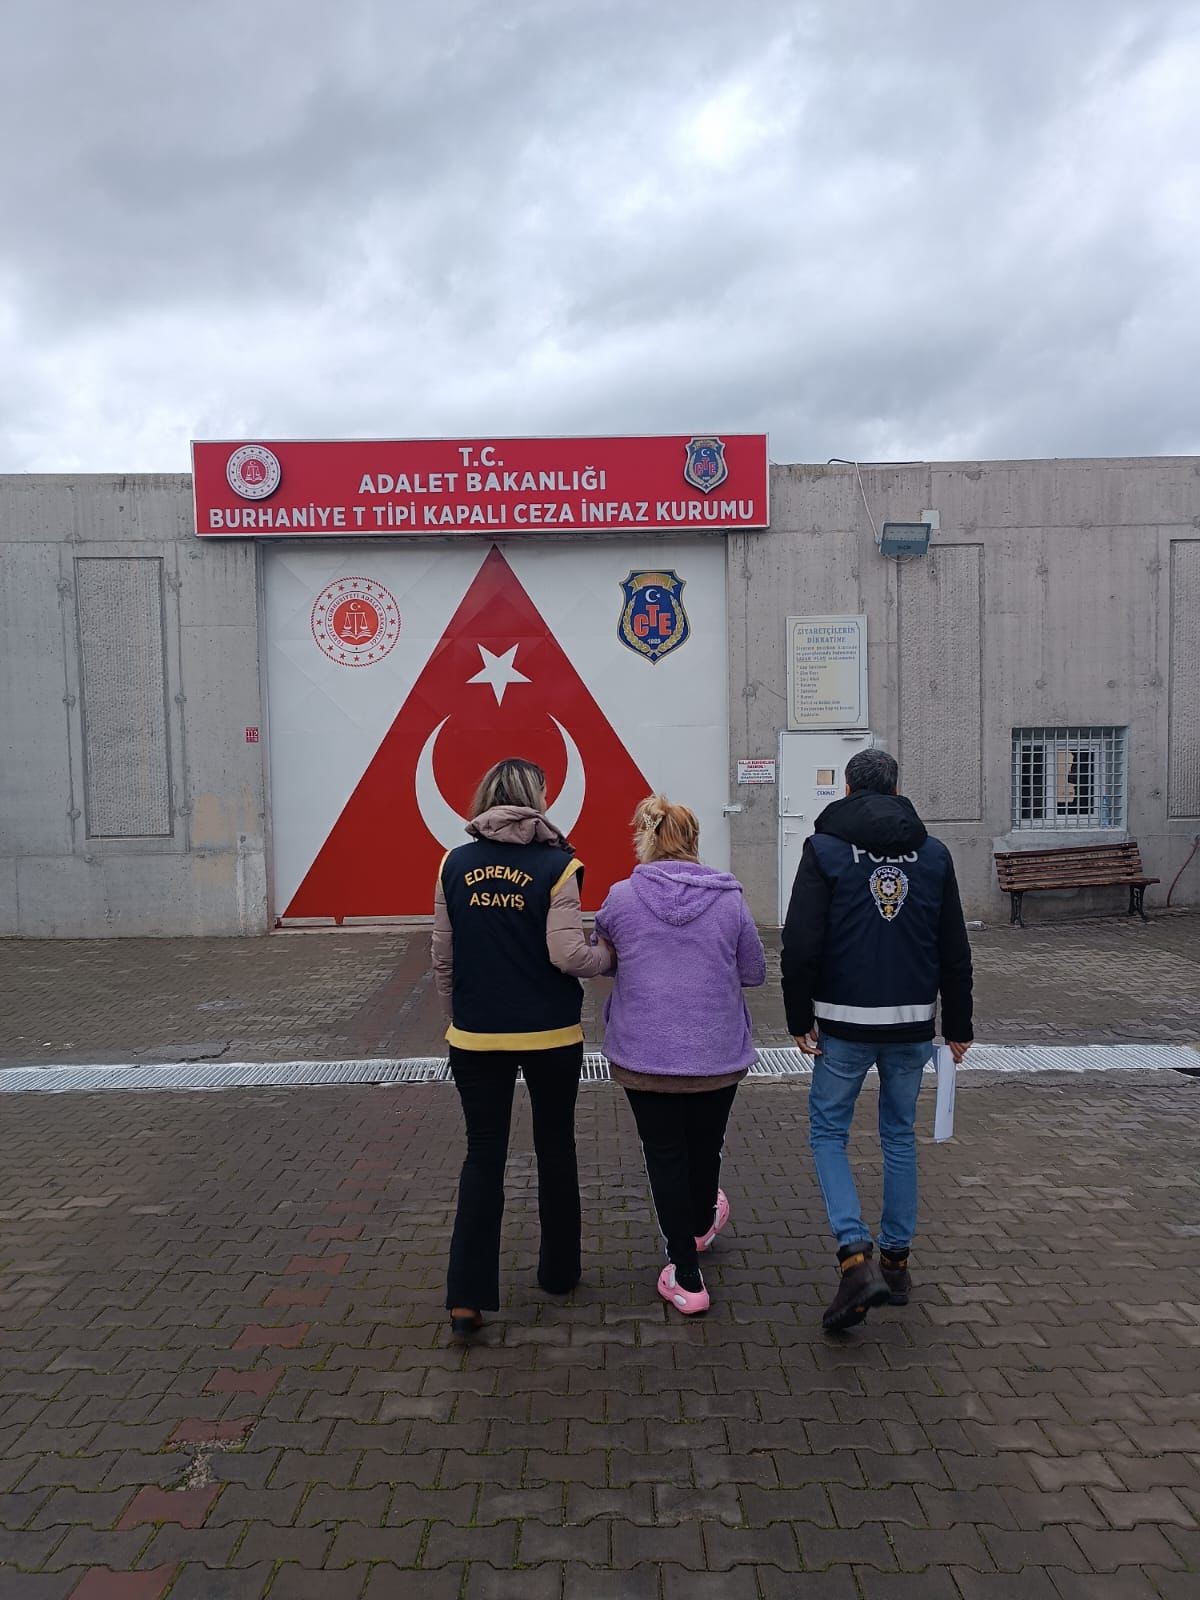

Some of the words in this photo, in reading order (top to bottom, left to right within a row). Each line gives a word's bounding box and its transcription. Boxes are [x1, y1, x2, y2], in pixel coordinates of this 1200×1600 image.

[458, 447, 504, 467] T.C.
[358, 473, 459, 494] ADALET
[466, 465, 606, 492] BAKANLIĞI
[209, 503, 346, 529] BURHANİYE
[352, 507, 366, 526] T
[372, 502, 416, 526] TİPİ
[423, 503, 507, 525] KAPALI
[513, 502, 575, 524] CEZA
[581, 499, 649, 522] İNFAZ
[656, 499, 754, 521] KURUMU
[464, 865, 534, 888] EDREMİT
